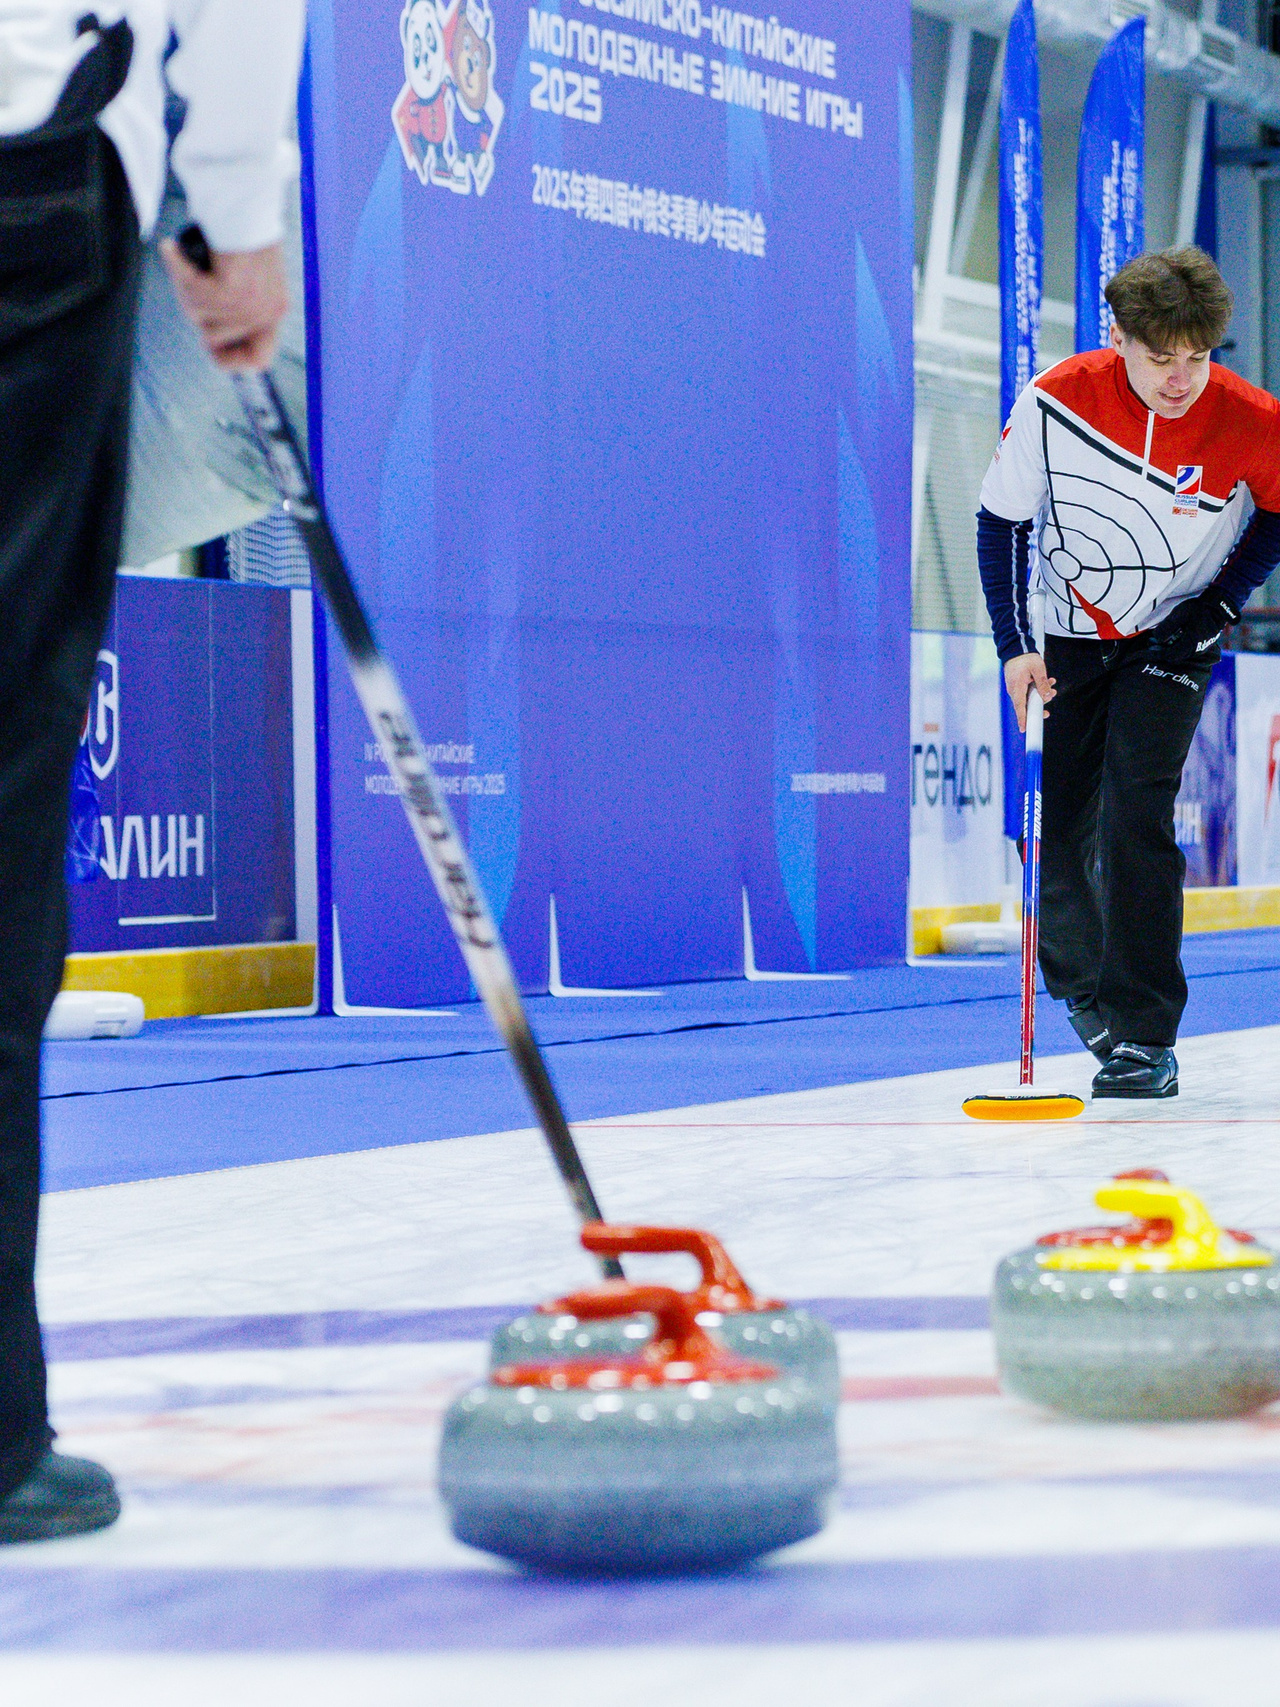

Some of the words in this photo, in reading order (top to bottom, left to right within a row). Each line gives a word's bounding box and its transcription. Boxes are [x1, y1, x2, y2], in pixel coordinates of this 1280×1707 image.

[528, 7, 705, 96] МОЛОДЕЖНЫЕ
[709, 59, 801, 123] ЗИМНИЕ
[805, 86, 864, 140] ИГРЫ
[529, 60, 602, 125] 2025
[1141, 663, 1200, 692] Hardline
